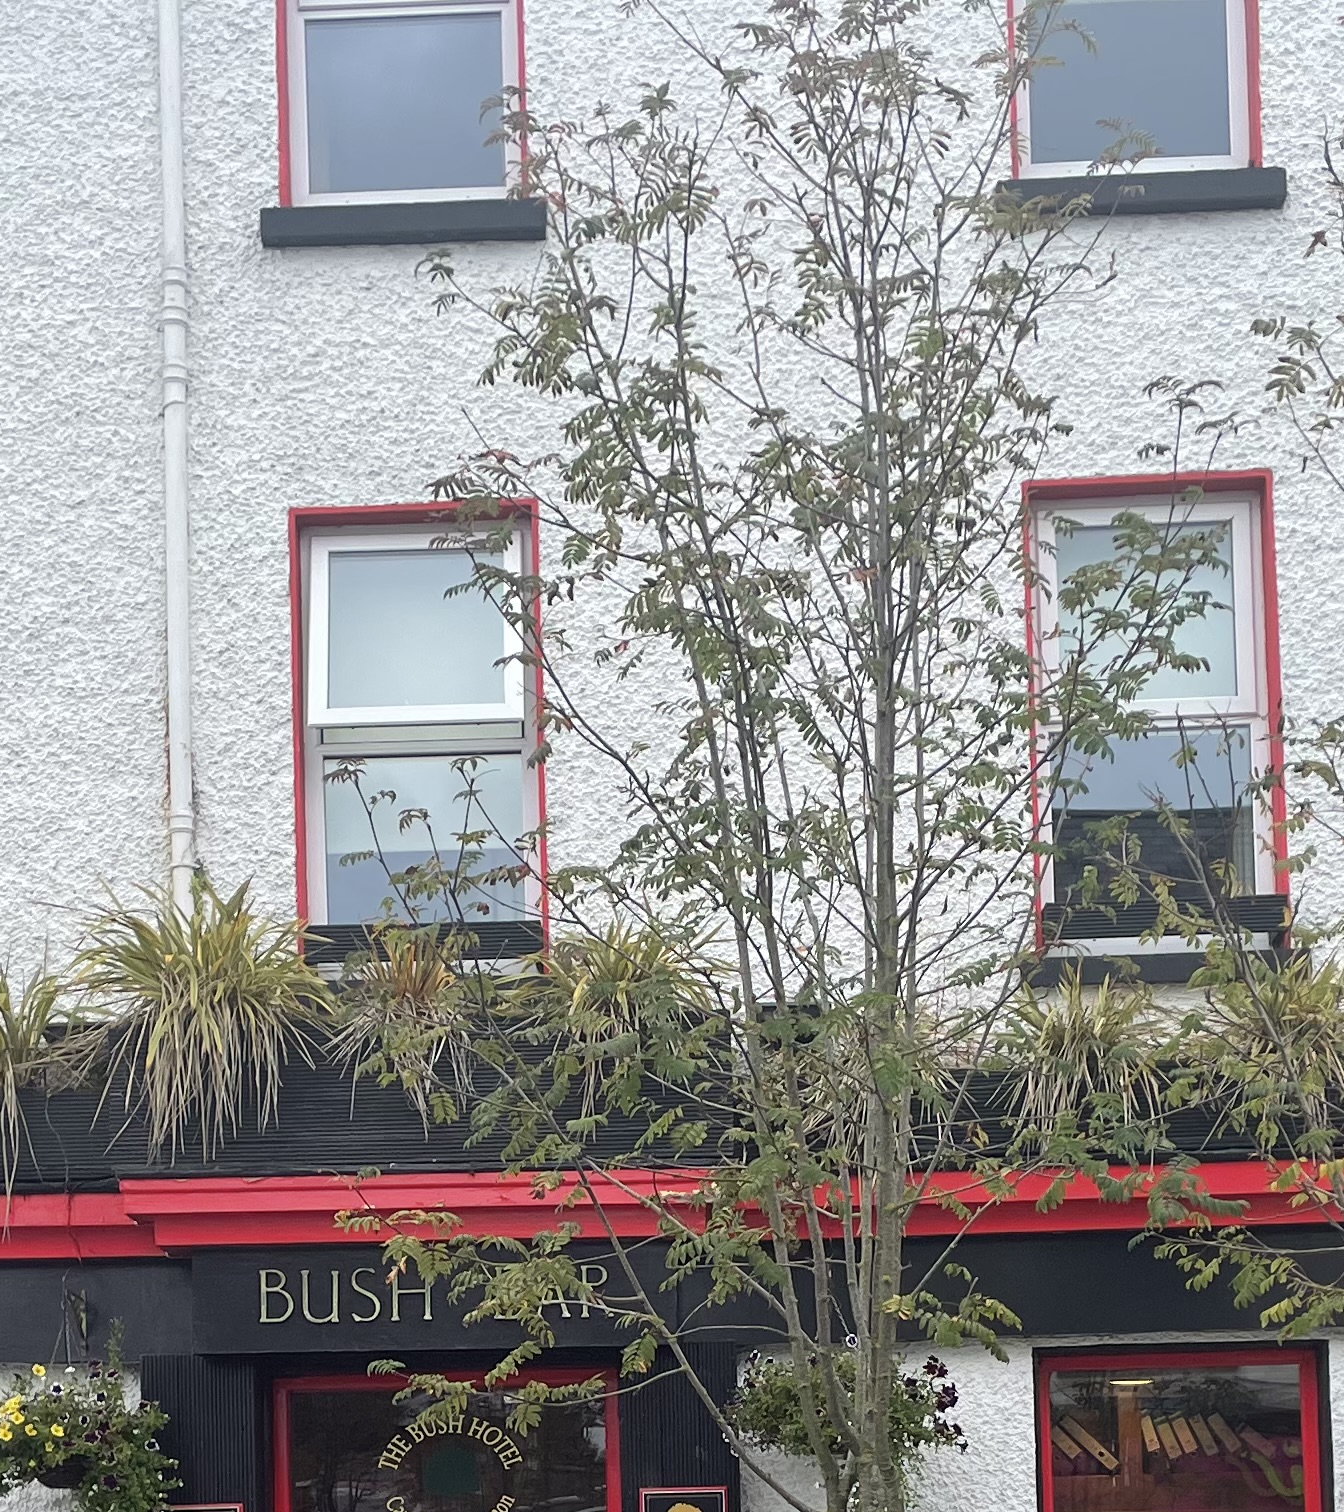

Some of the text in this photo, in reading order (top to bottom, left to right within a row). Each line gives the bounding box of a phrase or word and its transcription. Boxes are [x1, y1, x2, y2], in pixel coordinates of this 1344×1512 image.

[259, 1264, 615, 1324] BUSH AR
[378, 1414, 523, 1470] THE BUSH HOTEL
